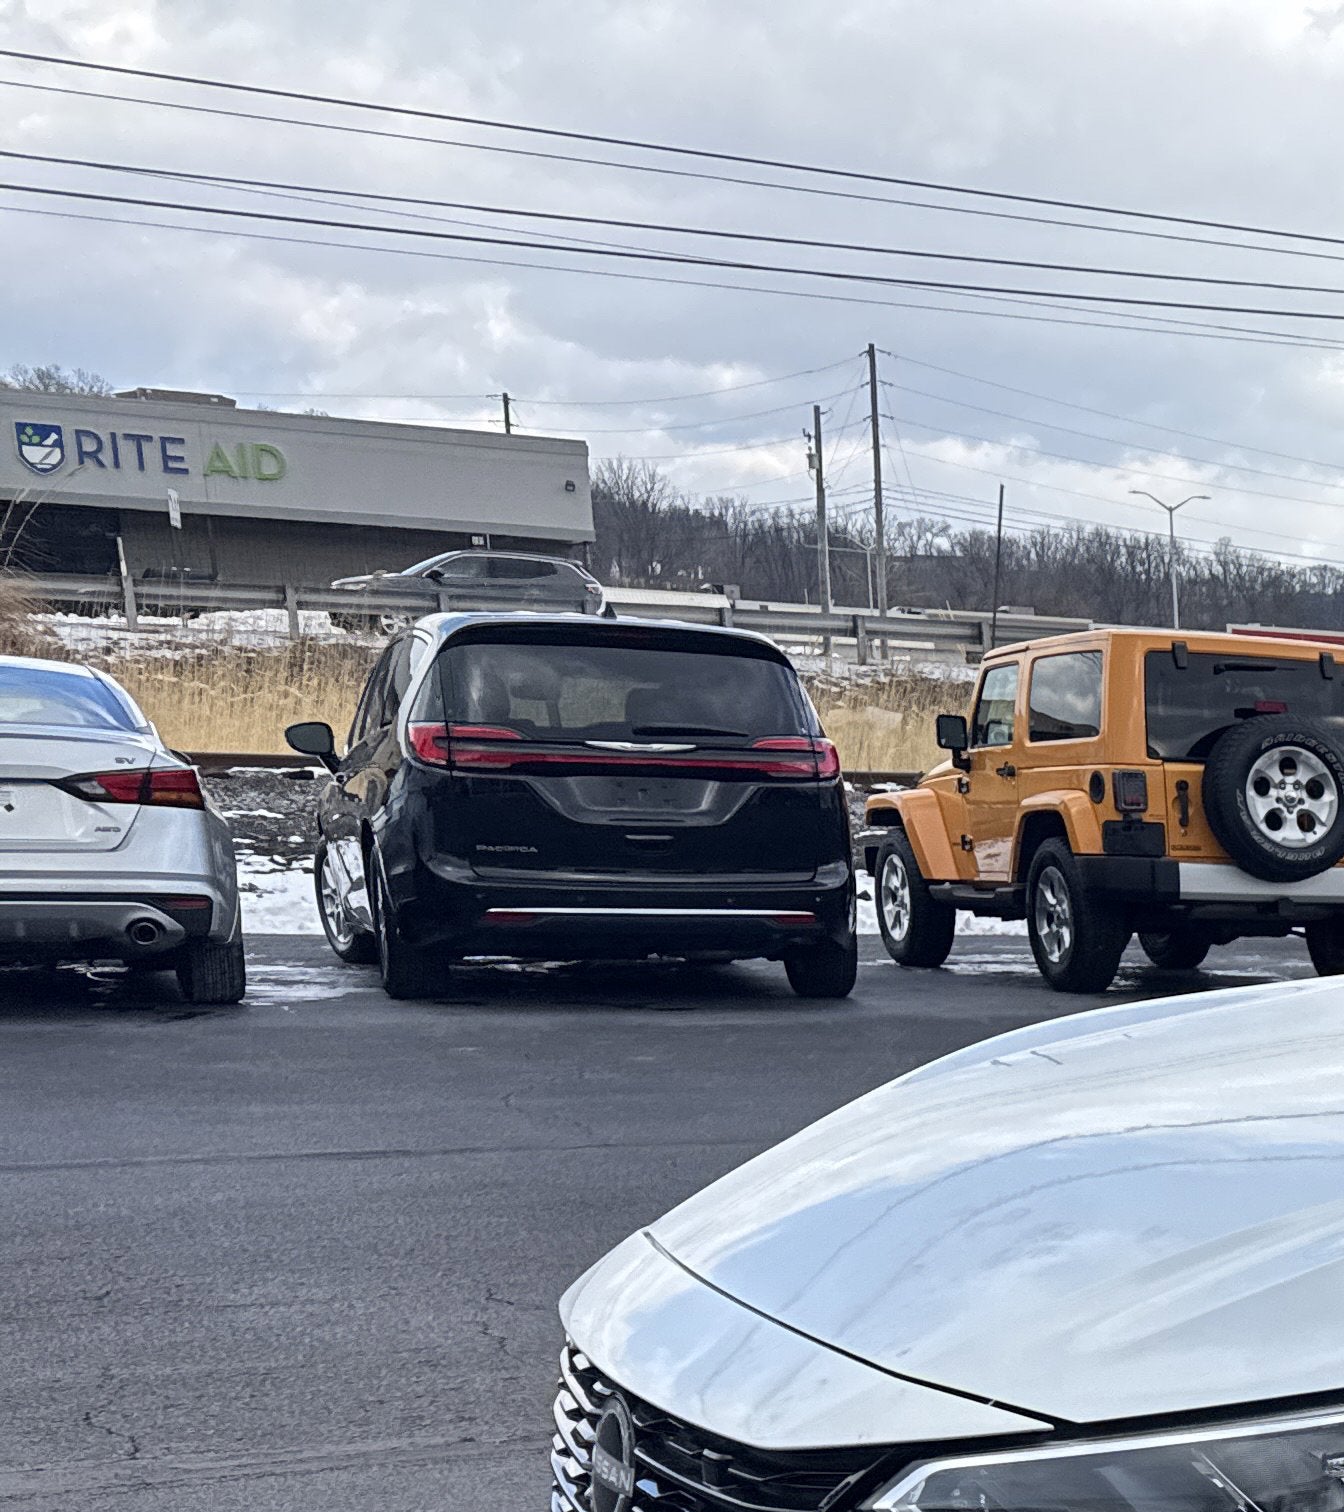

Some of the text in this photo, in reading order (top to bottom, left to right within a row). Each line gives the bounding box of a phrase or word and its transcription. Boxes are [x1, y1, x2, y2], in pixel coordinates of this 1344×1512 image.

[74, 428, 287, 481] RITE AID
[114, 756, 136, 765] SV
